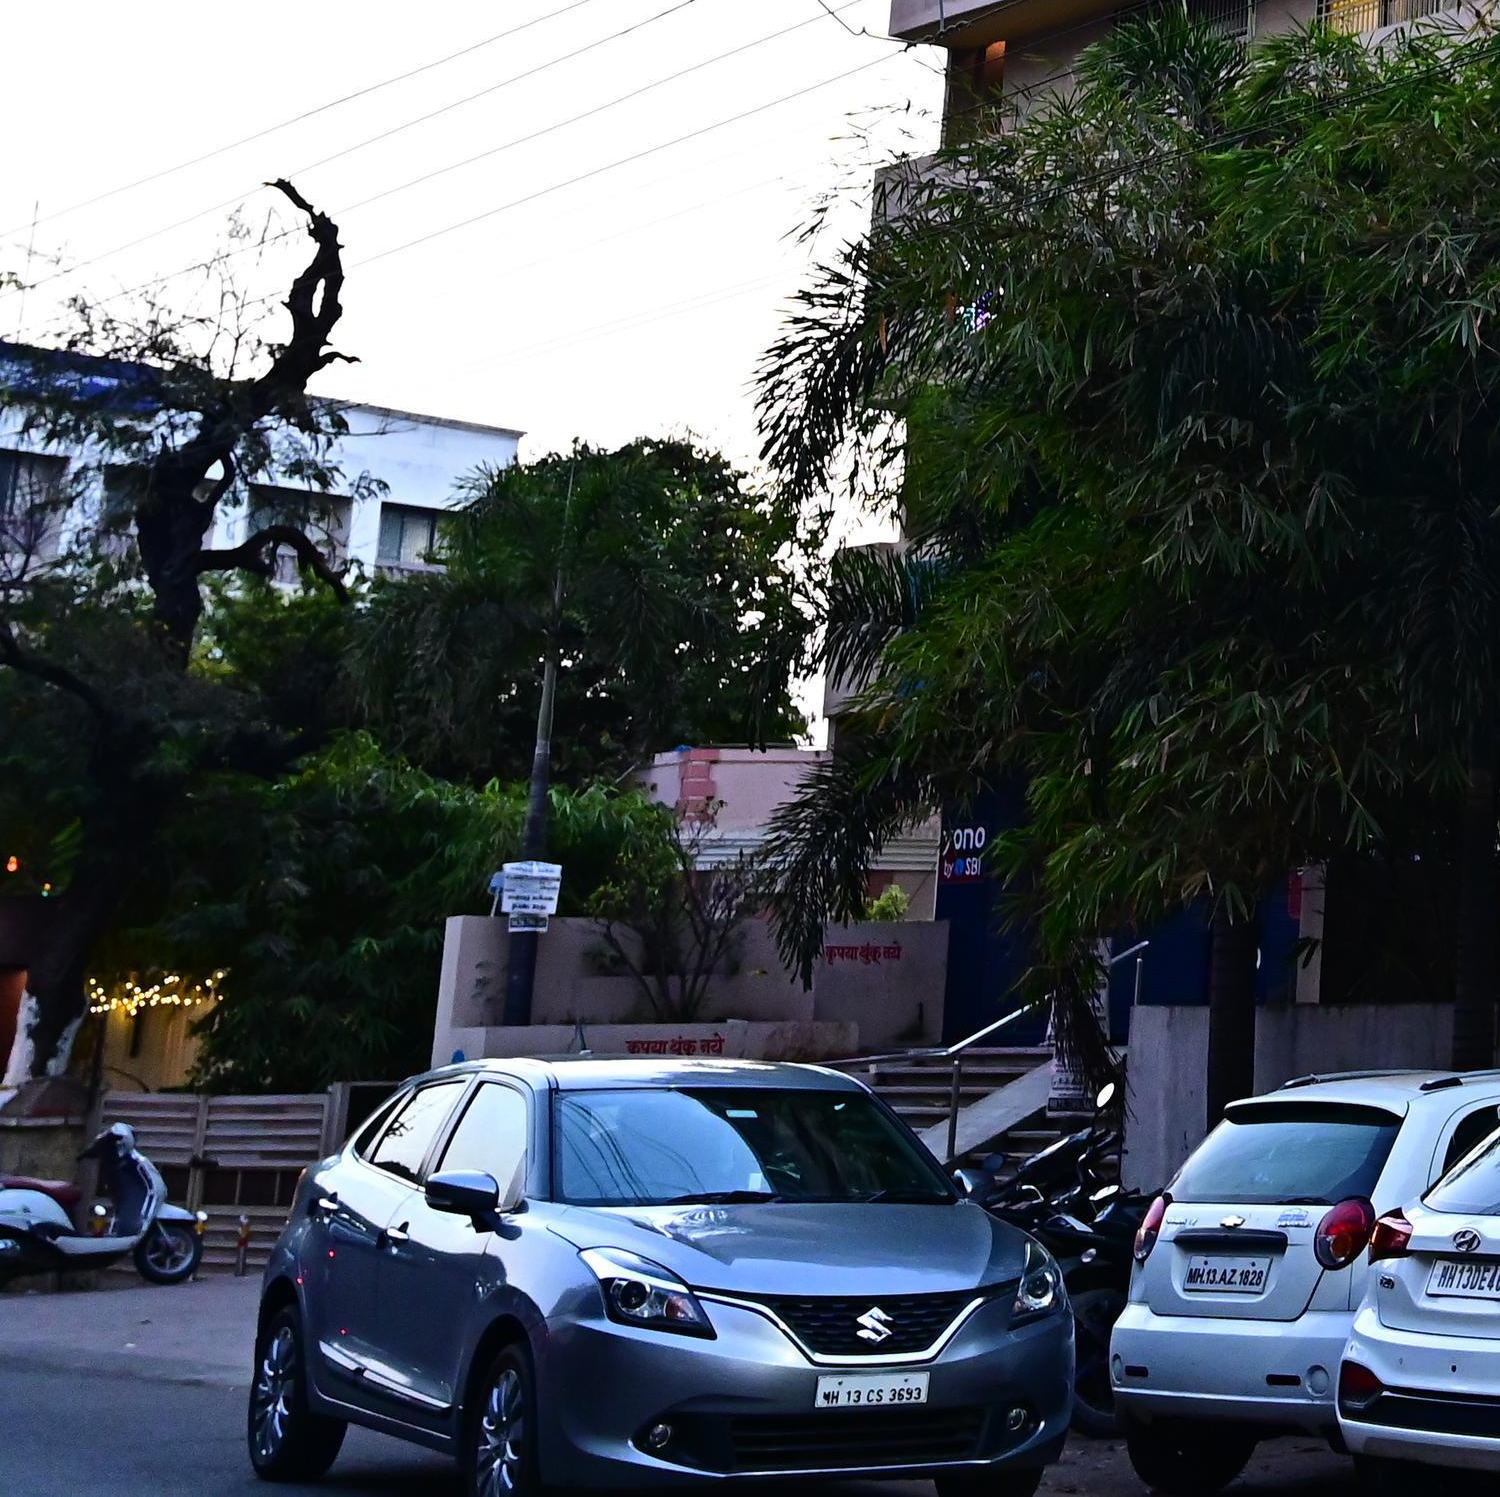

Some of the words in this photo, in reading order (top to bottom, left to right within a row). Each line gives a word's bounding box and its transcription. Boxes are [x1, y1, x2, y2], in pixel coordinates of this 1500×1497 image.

[944, 859, 953, 878] by
[965, 857, 981, 876] SBI
[846, 1389, 861, 1403] 13
[867, 1389, 883, 1403] CS
